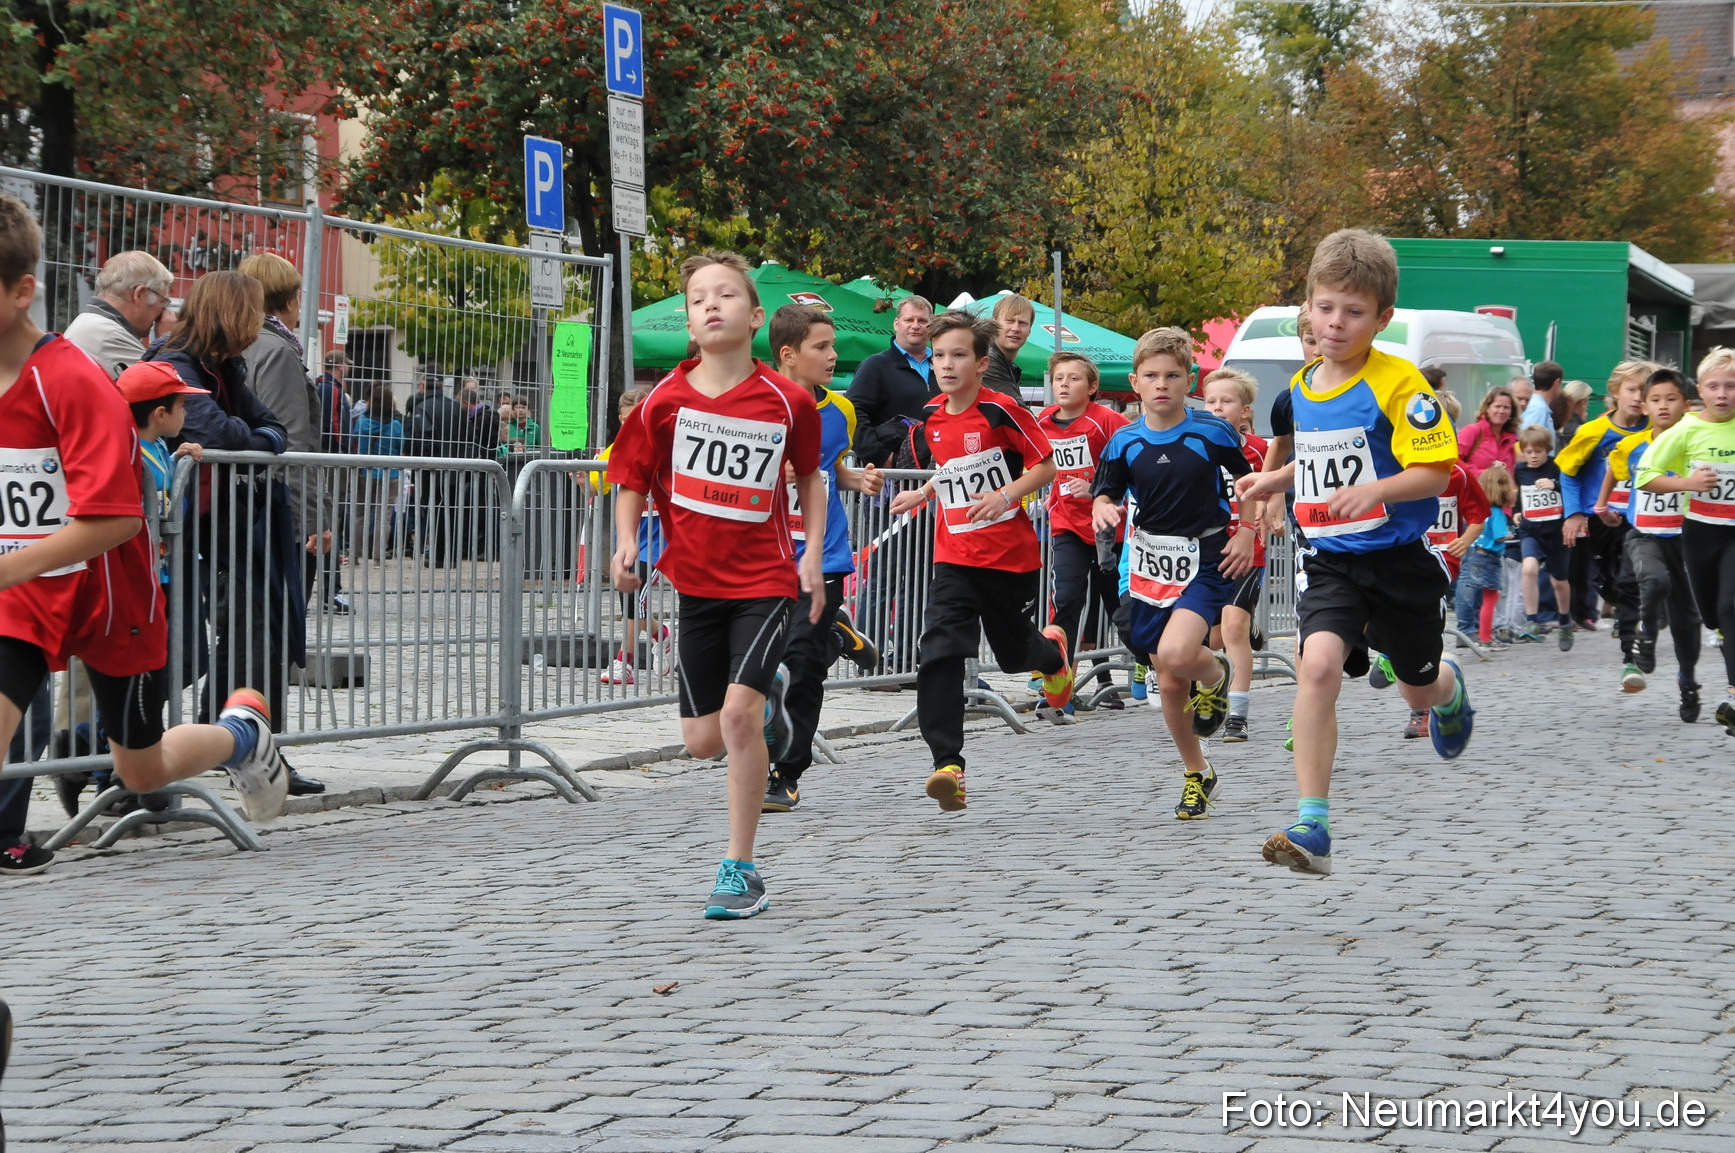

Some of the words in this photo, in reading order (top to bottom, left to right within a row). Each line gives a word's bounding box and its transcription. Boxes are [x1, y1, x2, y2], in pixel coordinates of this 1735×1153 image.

[613, 17, 635, 82] P
[612, 116, 641, 133] Parkschein
[615, 133, 639, 149] werktags
[533, 150, 554, 216] P
[679, 418, 714, 433] PARTL
[716, 425, 768, 442] Neumarkt
[1411, 431, 1451, 447] PARTL
[1307, 441, 1349, 453] Neumarkt
[1413, 438, 1453, 452] Neumarkt
[686, 435, 774, 483] 7037
[1055, 446, 1084, 467] 067
[0, 463, 38, 474] umarkt
[935, 468, 953, 477] ARTL
[953, 458, 991, 473] Neumarkt
[1299, 455, 1363, 497] 7142
[703, 485, 740, 505] Lauri
[939, 466, 1006, 504] 7120
[0, 481, 61, 528] 62
[1526, 492, 1558, 508] 7539
[1642, 492, 1686, 513] 754
[1135, 545, 1191, 582] 7598
